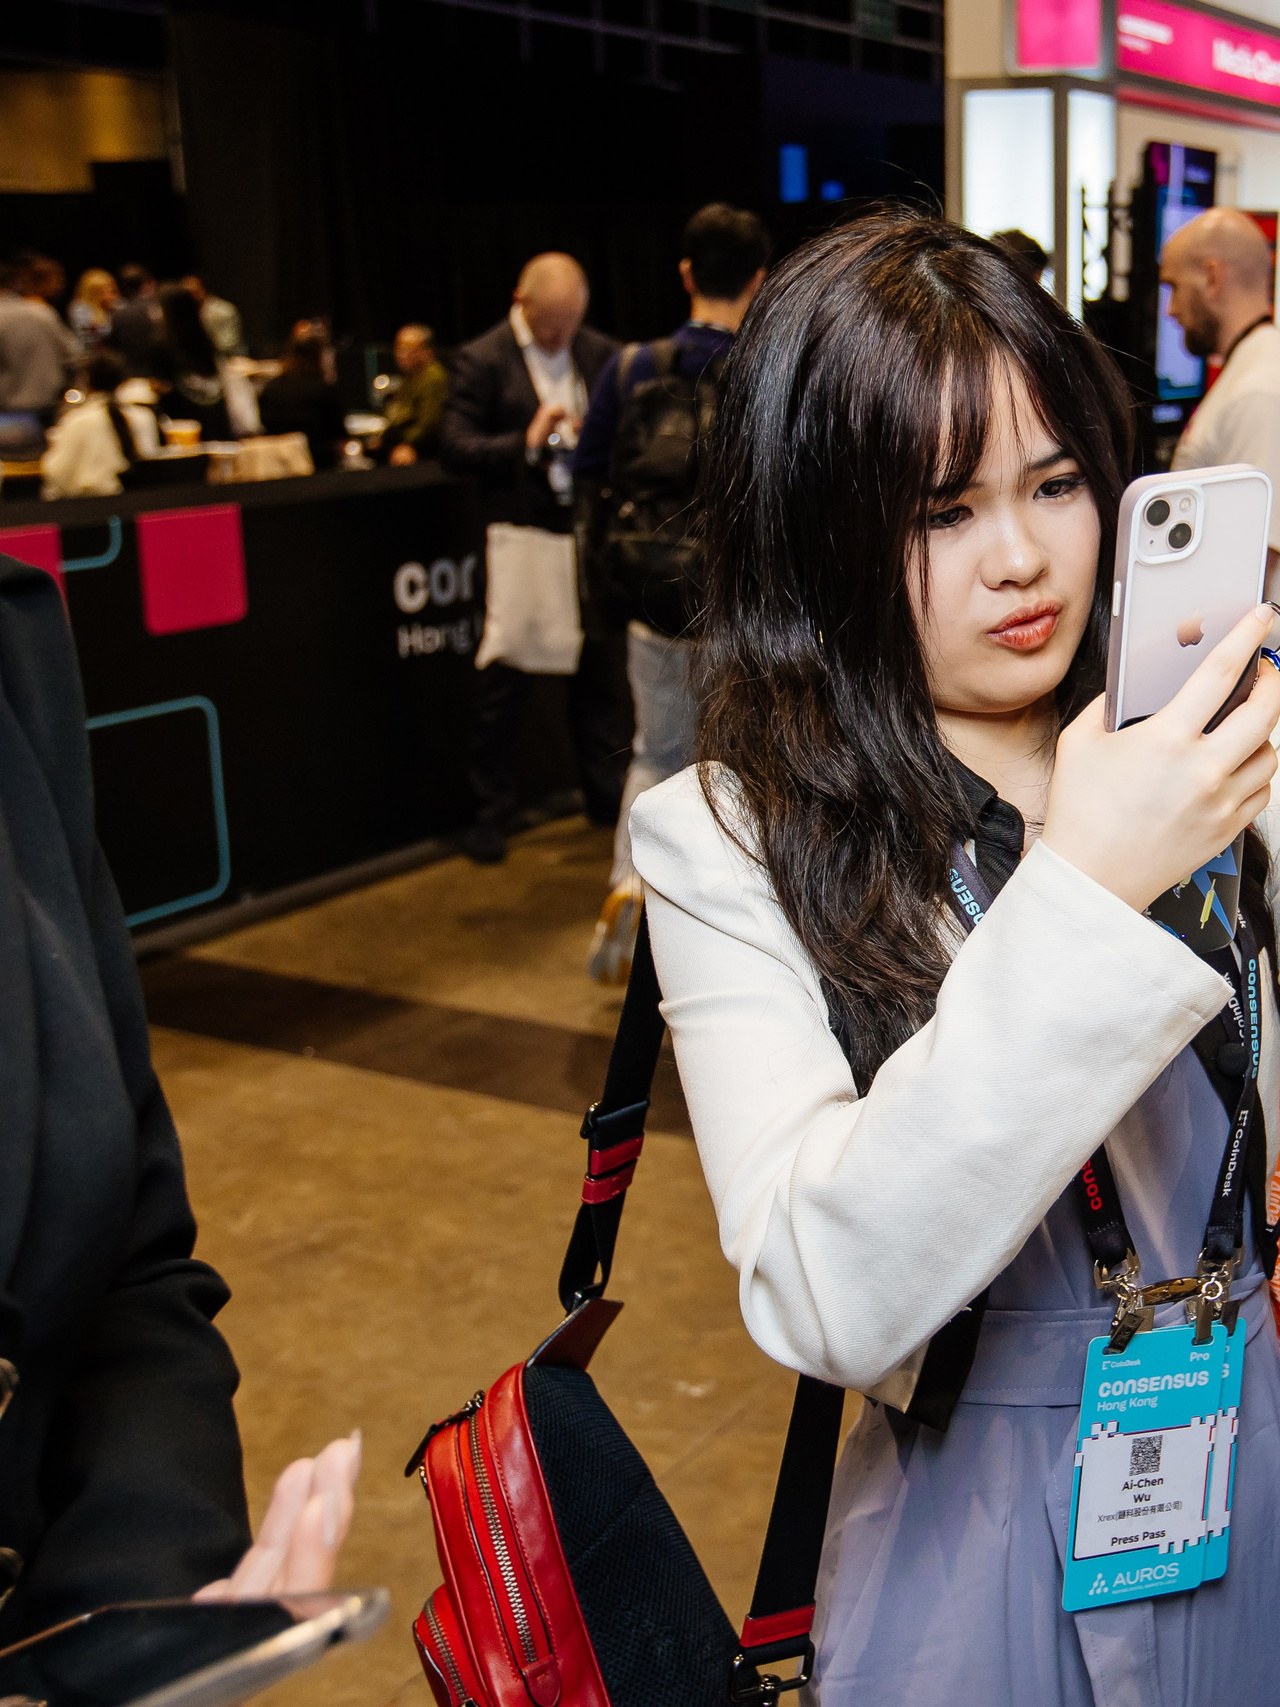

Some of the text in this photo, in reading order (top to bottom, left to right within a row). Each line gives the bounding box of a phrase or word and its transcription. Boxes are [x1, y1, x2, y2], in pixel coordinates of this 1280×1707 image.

[1221, 1128, 1244, 1197] CoinDesk
[1189, 1351, 1210, 1363] Pro
[1096, 1396, 1158, 1412] Hong Kong
[1121, 1477, 1164, 1491] Ai-Chen
[1133, 1493, 1151, 1504] Wu
[1110, 1529, 1166, 1547] Press Pass
[1112, 1562, 1180, 1588] AUROS
